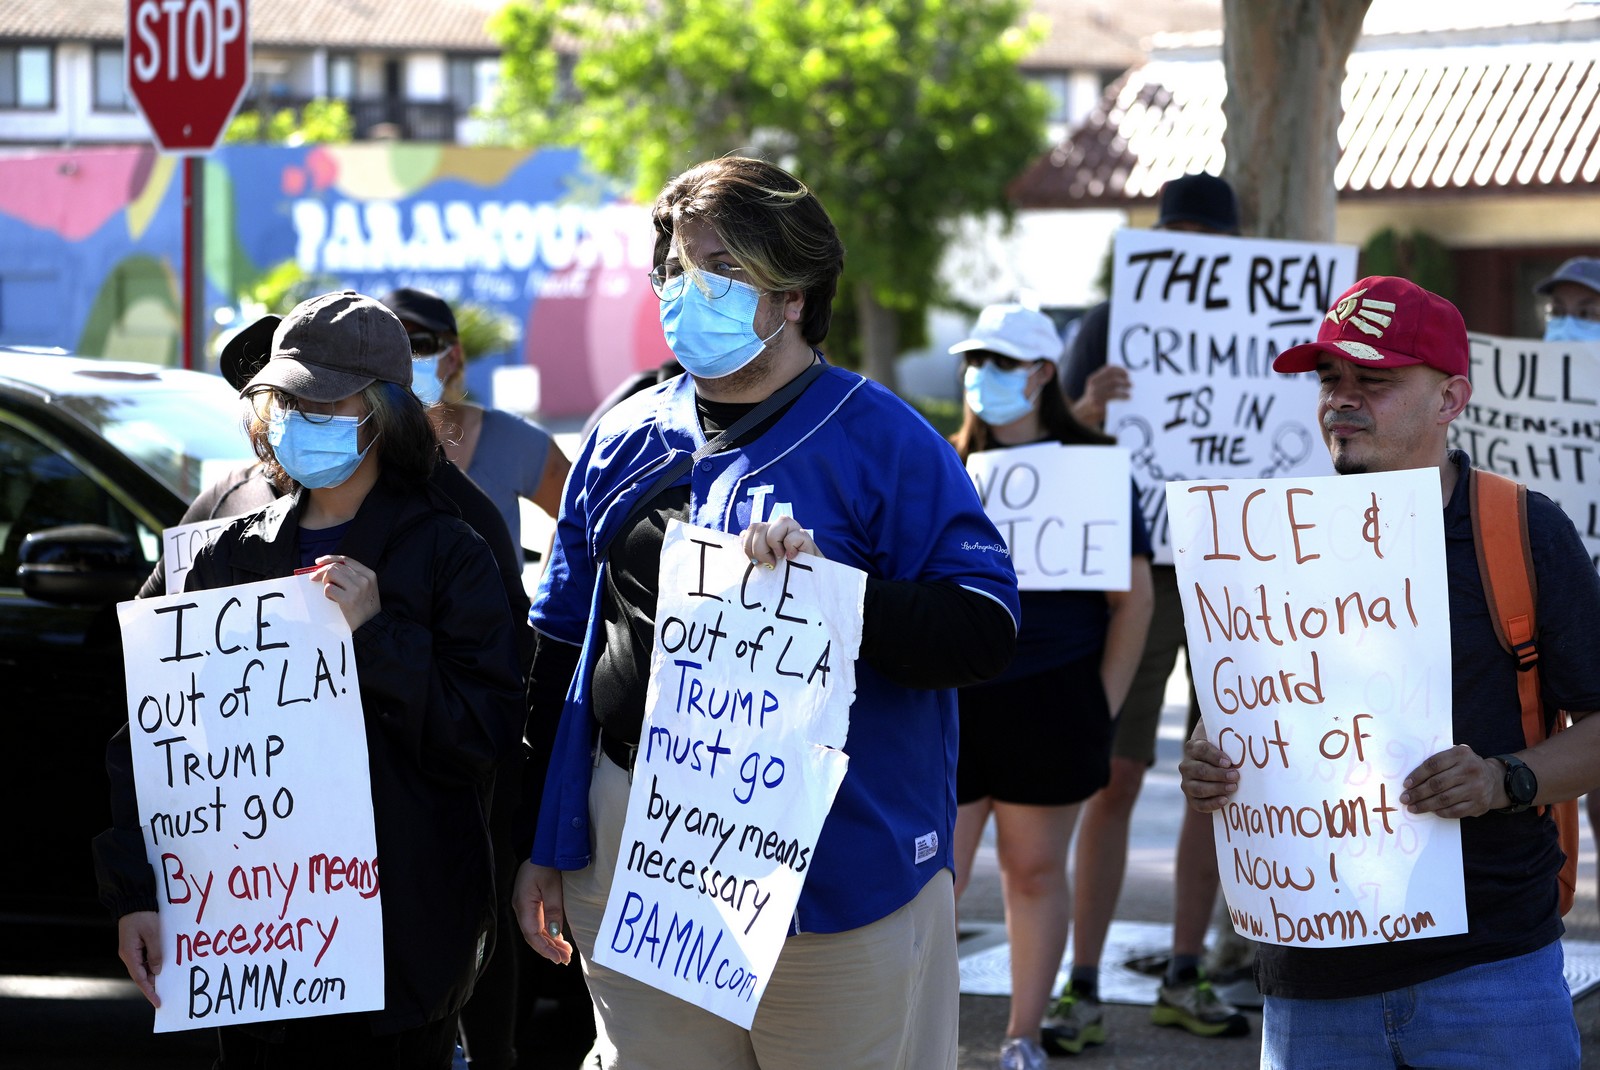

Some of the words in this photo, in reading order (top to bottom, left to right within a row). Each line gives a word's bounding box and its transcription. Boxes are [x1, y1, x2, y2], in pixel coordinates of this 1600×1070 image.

[134, 0, 242, 82] STOP
[1128, 248, 1231, 310] THE
[1468, 338, 1597, 406] FULL
[1163, 386, 1214, 430] IS
[1235, 392, 1275, 432] IN
[1191, 435, 1252, 466] THE
[1449, 422, 1600, 482] RIGHT
[994, 516, 1118, 577] ICE
[1188, 485, 1321, 565] ICE
[1362, 492, 1384, 559] &
[154, 592, 289, 662] I.C.E
[1195, 577, 1418, 646] National
[220, 659, 264, 718] of
[277, 641, 347, 707] LA!
[736, 626, 774, 672] of
[776, 636, 830, 688] LA
[1213, 651, 1325, 715] Guard
[646, 725, 731, 778] must
[733, 752, 785, 804] go
[150, 786, 226, 845] must
[243, 787, 293, 839] go
[647, 774, 682, 843] by
[684, 807, 735, 865] any
[739, 824, 810, 872] means
[161, 853, 213, 924] By
[228, 862, 299, 920] any
[309, 853, 380, 899] means
[627, 840, 771, 936] necessary
[1229, 897, 1436, 943] www.bamn.com
[176, 915, 338, 967] necessary
[611, 891, 757, 1002] BAMN.com
[189, 958, 345, 1019] BAMN.com
